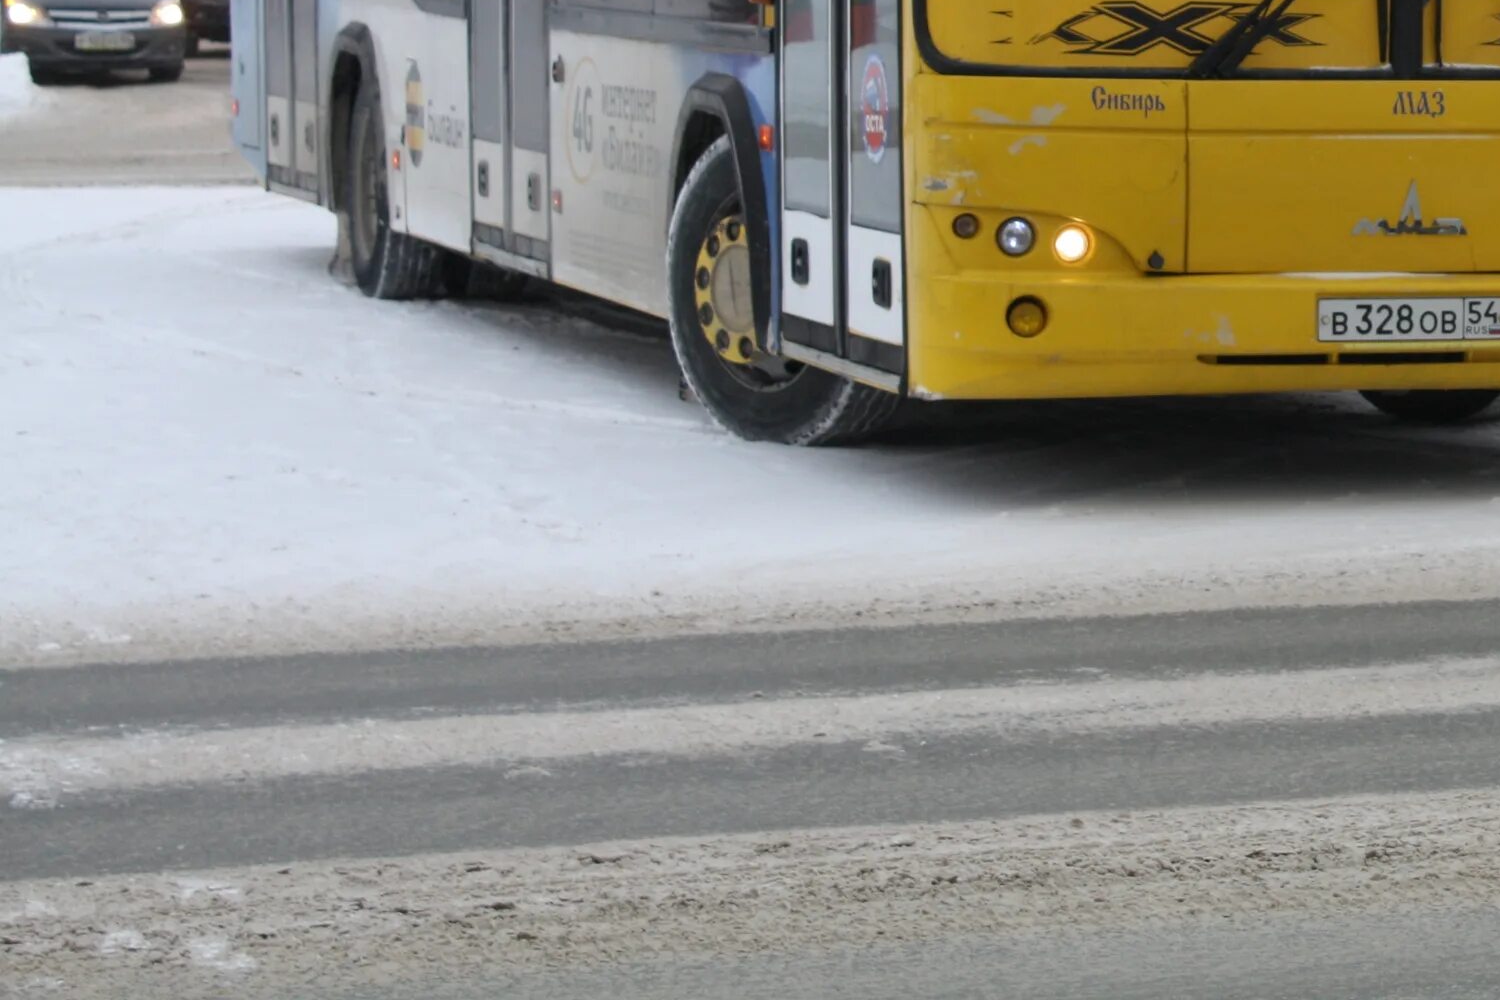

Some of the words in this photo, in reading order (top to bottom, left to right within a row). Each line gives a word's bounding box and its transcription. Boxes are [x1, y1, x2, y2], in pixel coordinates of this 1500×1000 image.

[1091, 86, 1166, 118] Сибирь
[1392, 89, 1446, 118] МАЗ
[573, 85, 593, 152] 4G
[1467, 300, 1498, 324] 54
[1465, 325, 1488, 335] RUS
